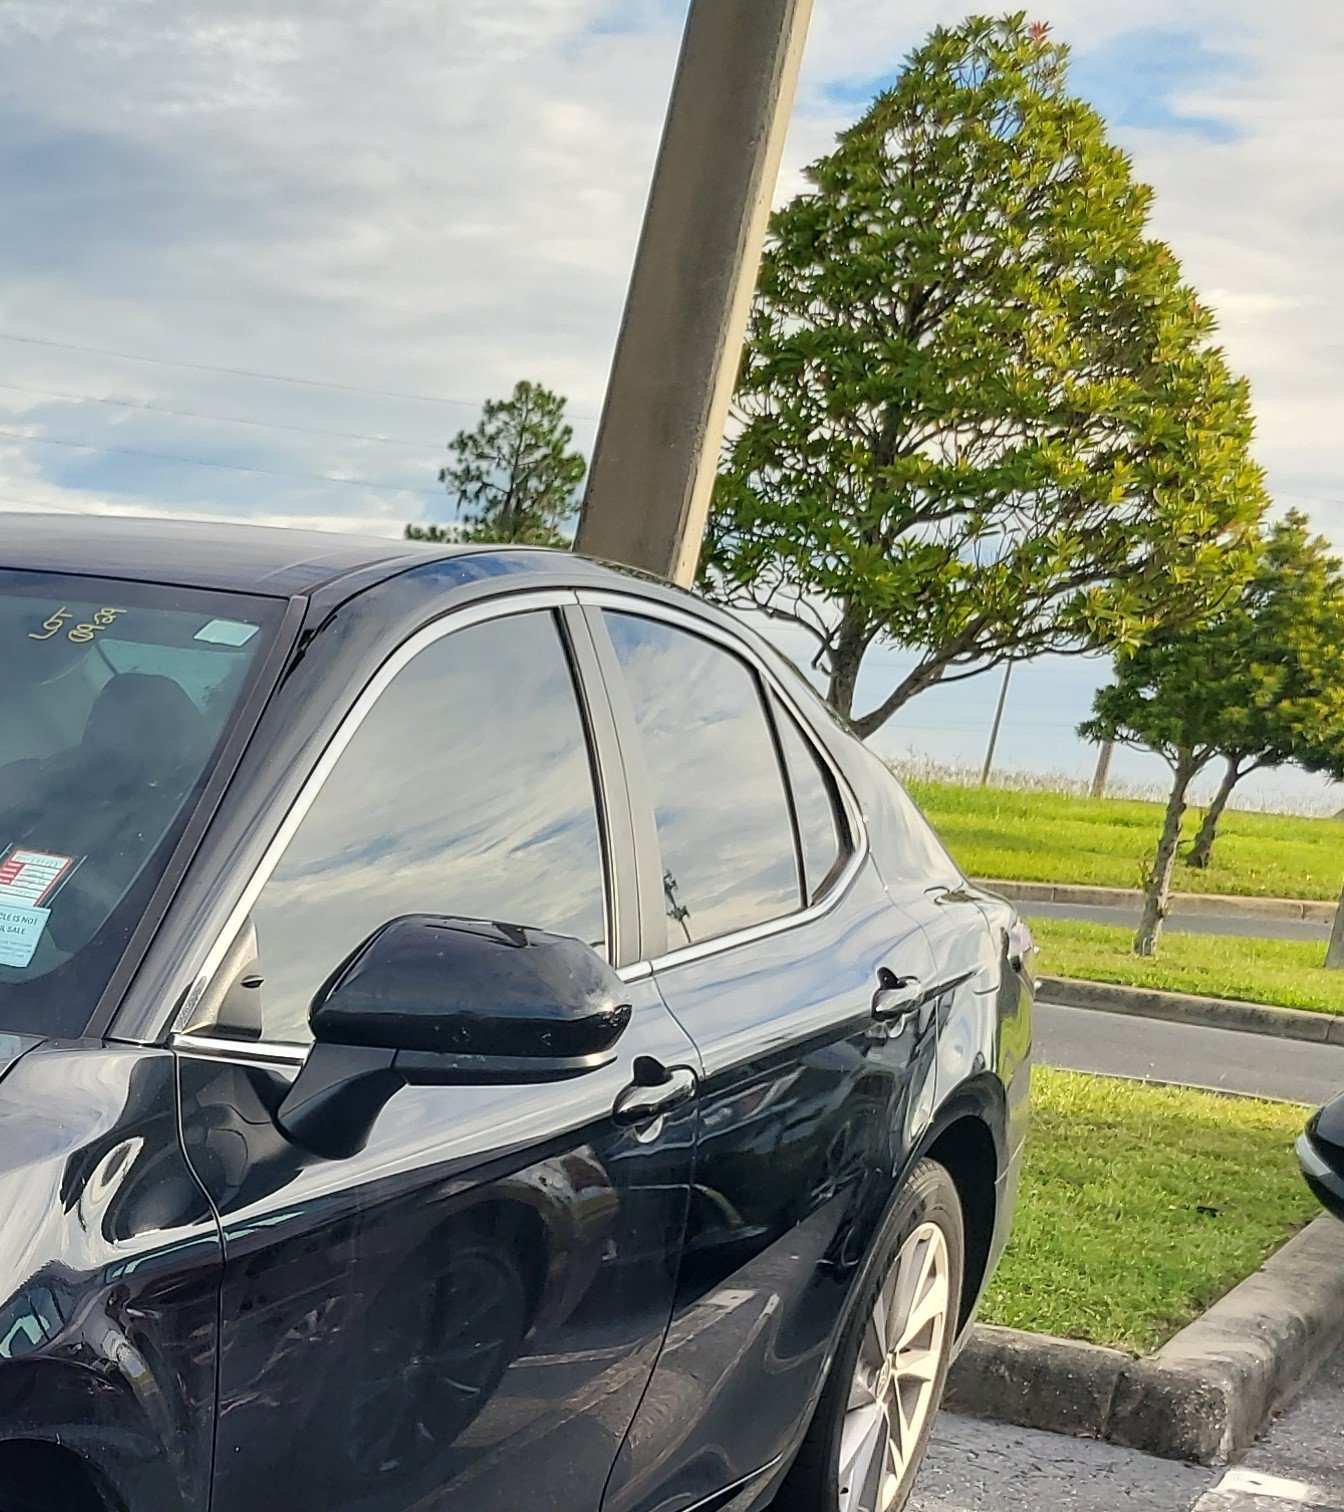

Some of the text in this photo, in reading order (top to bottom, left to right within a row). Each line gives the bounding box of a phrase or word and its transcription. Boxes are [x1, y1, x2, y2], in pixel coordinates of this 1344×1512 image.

[12, 914, 21, 923] IS
[22, 915, 39, 926] NOT
[6, 925, 26, 935] SALE
